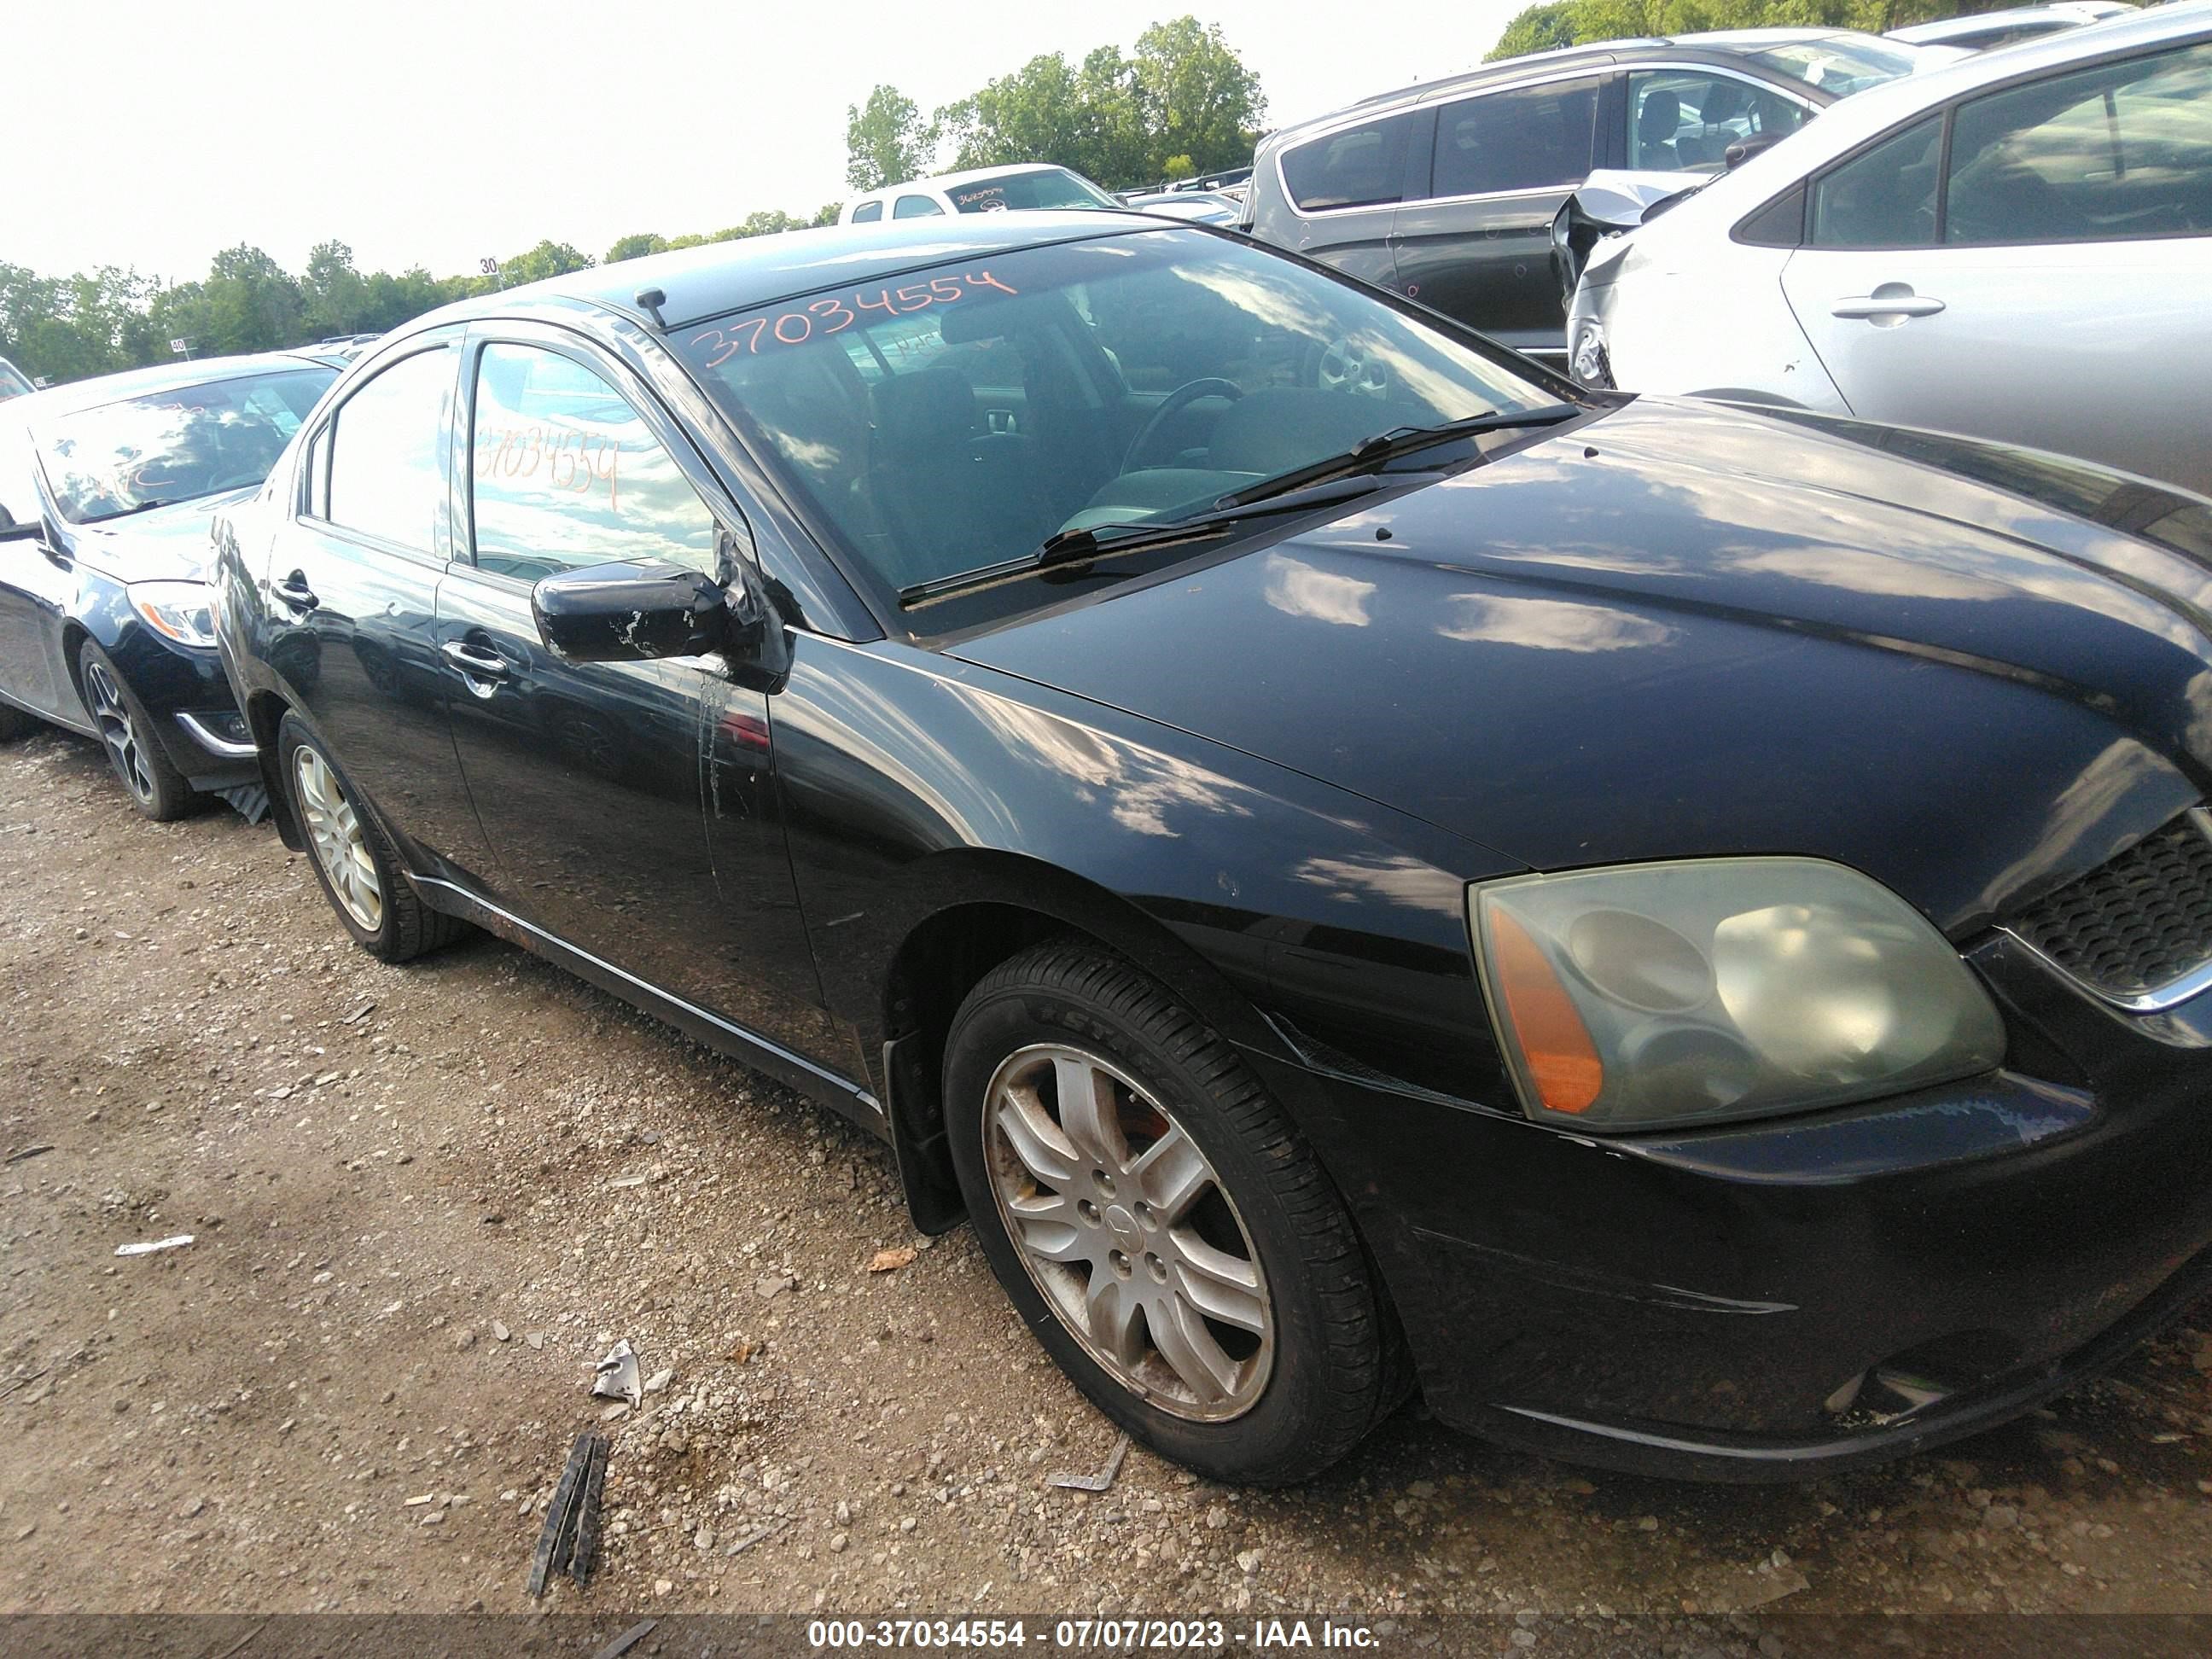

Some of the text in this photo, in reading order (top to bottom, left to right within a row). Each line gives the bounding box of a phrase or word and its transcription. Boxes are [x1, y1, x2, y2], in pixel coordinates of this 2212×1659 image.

[480, 258, 497, 274] 30
[691, 271, 1018, 369] 37034554
[172, 341, 184, 351] 40
[476, 427, 620, 513] 37034554
